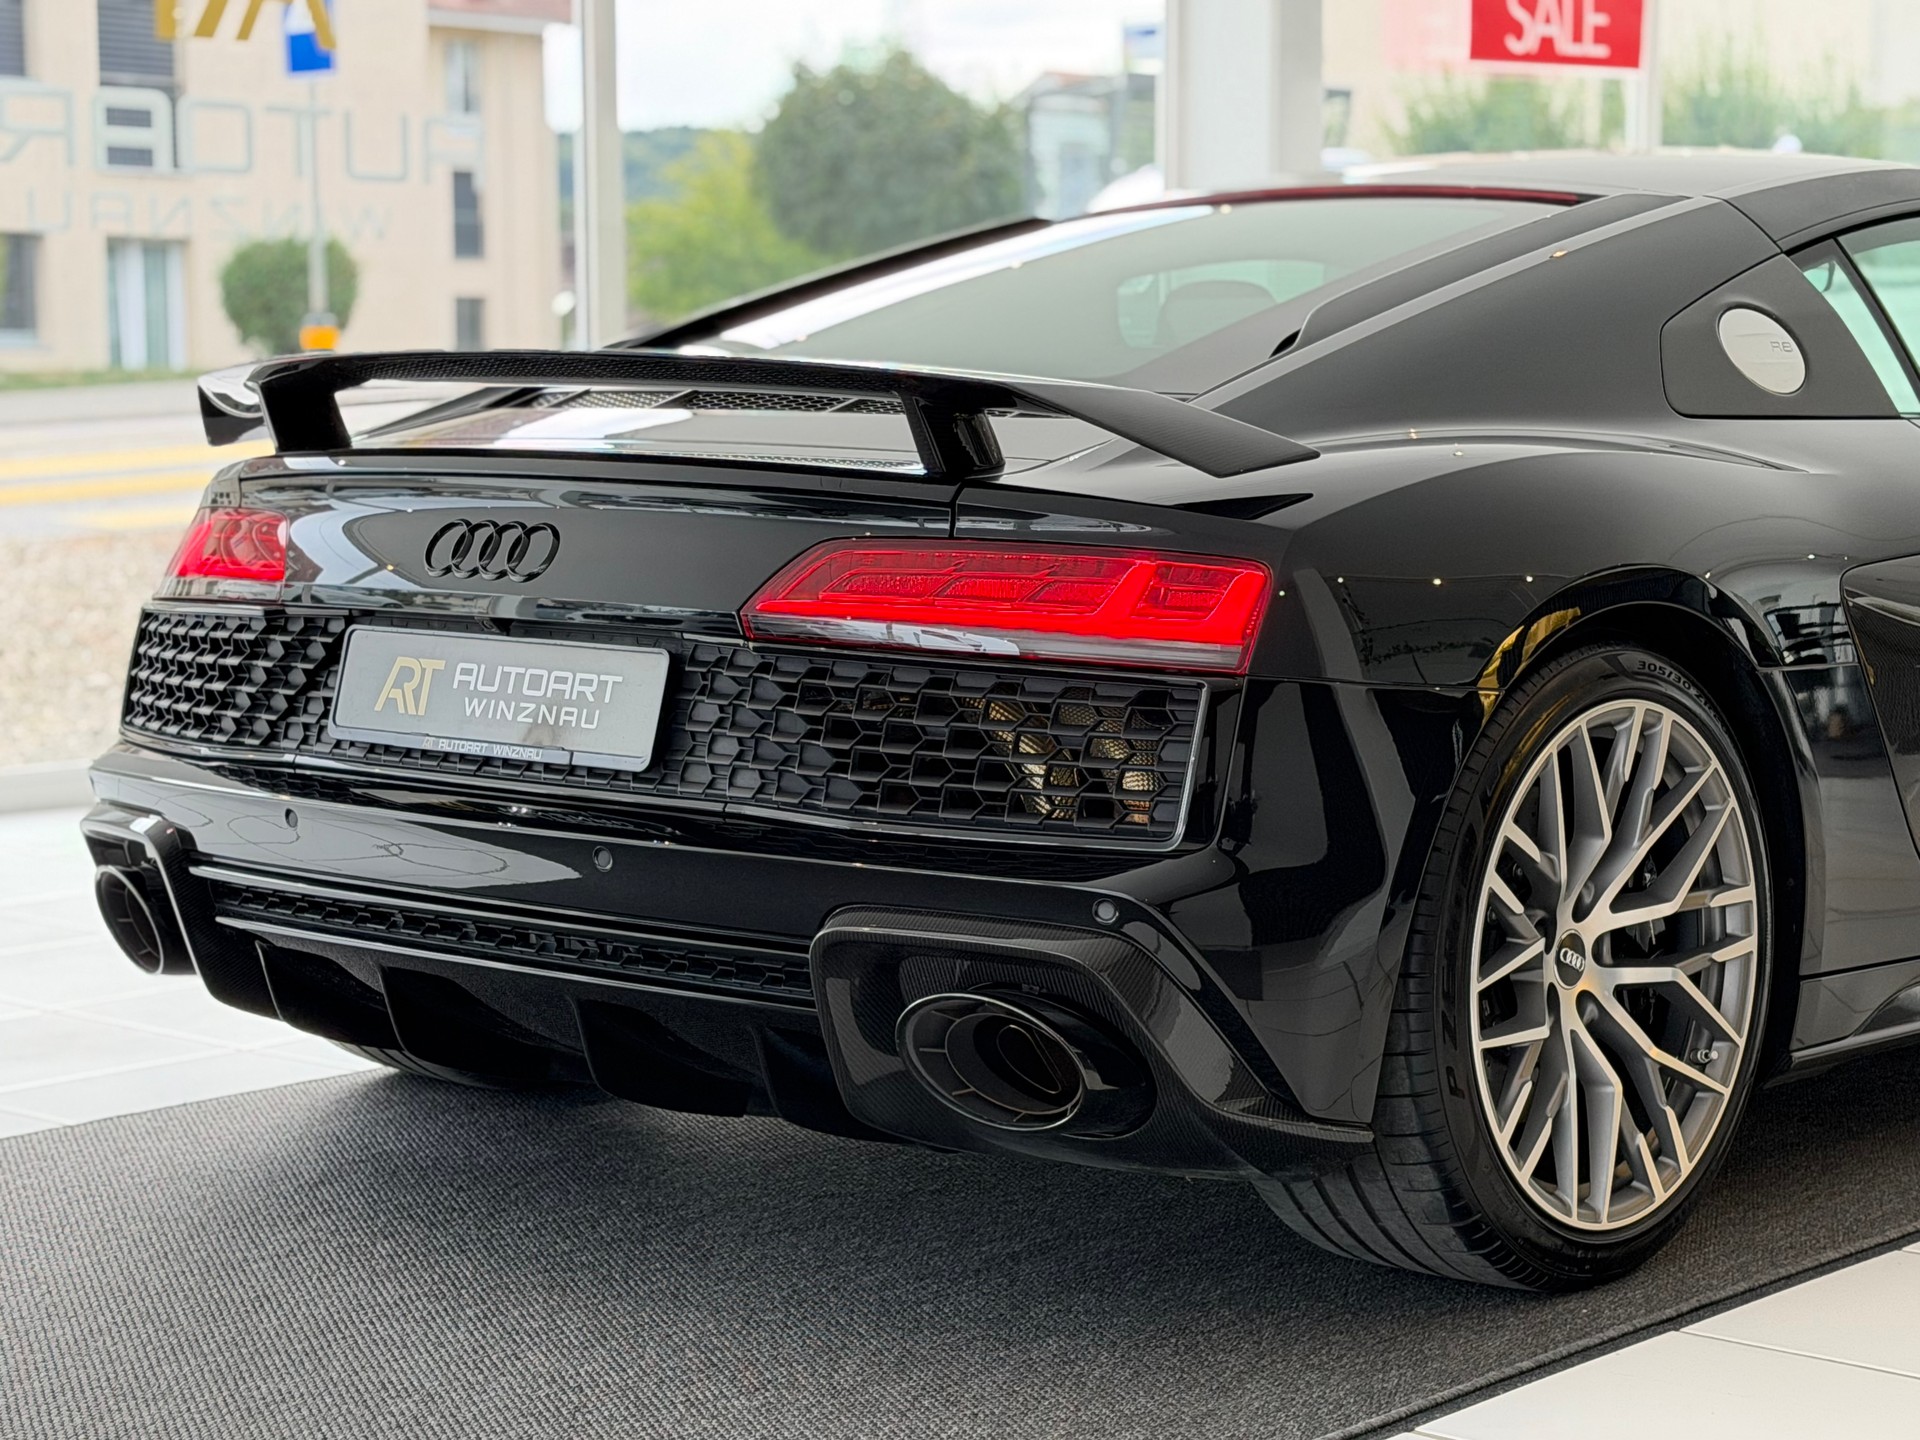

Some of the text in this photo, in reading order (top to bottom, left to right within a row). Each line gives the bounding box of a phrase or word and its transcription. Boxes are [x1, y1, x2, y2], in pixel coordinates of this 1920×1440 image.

[1503, 0, 1612, 59] SALE
[1770, 341, 1794, 353] R8
[452, 661, 623, 704] AUTOART
[1637, 660, 1691, 691] 305/30
[464, 696, 600, 730] WINZNAU
[438, 739, 488, 755] AUTOART
[493, 744, 543, 760] WINZNAU
